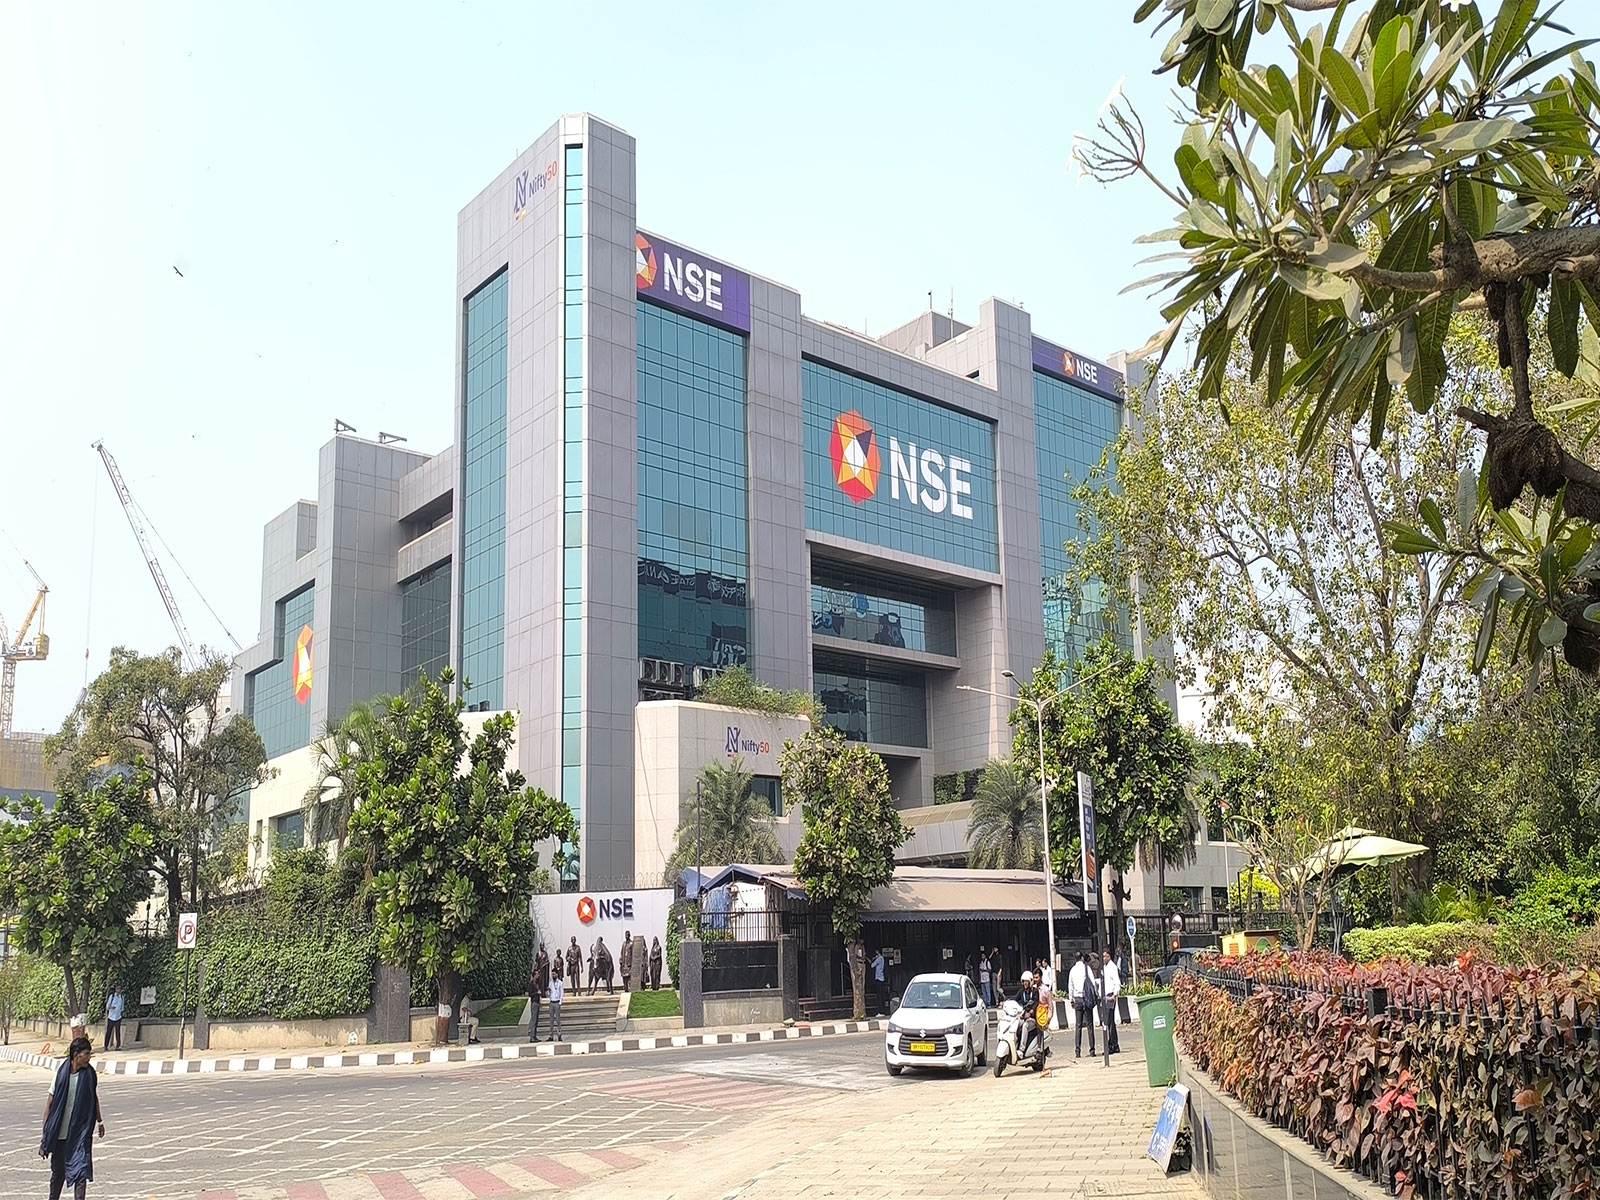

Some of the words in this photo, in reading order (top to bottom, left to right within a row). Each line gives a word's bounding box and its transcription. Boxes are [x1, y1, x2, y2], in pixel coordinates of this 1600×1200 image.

[529, 161, 558, 198] Nifty50
[664, 252, 723, 311] NSE
[1076, 359, 1098, 384] NSE
[890, 436, 973, 520] NSE
[741, 740, 770, 755] Nifty50
[599, 898, 634, 918] NSE
